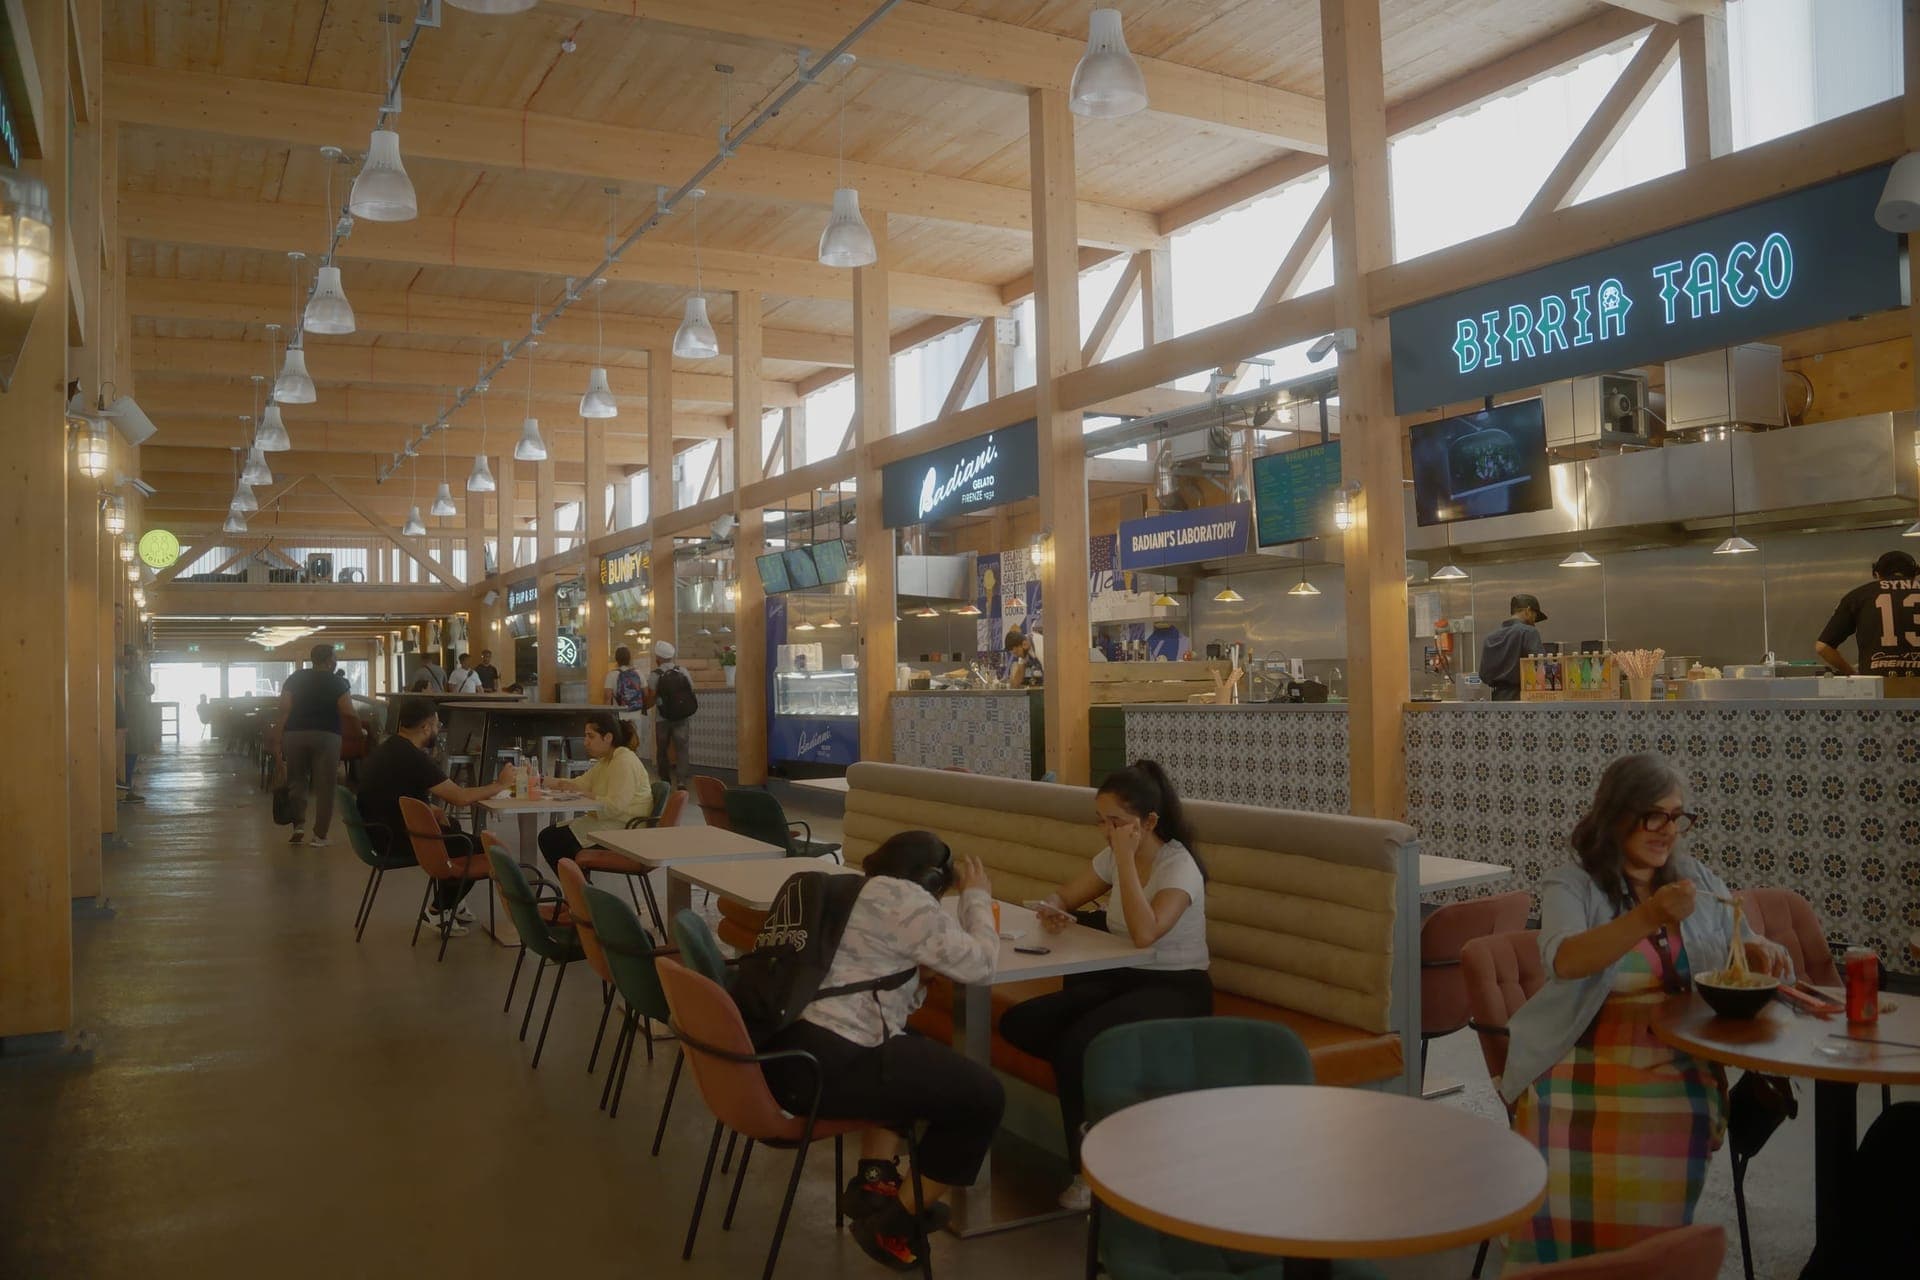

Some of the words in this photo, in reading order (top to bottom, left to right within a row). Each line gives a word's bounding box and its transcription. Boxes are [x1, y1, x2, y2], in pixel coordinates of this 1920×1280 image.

[1452, 278, 1634, 374] BIRRIA
[1653, 232, 1793, 325] TACO
[961, 491, 983, 504] FIRENZE
[972, 476, 995, 490] GELATO
[1132, 530, 1176, 552] BADIANI'S
[1177, 520, 1237, 546] LABORATORY
[1875, 593, 1920, 647] 13
